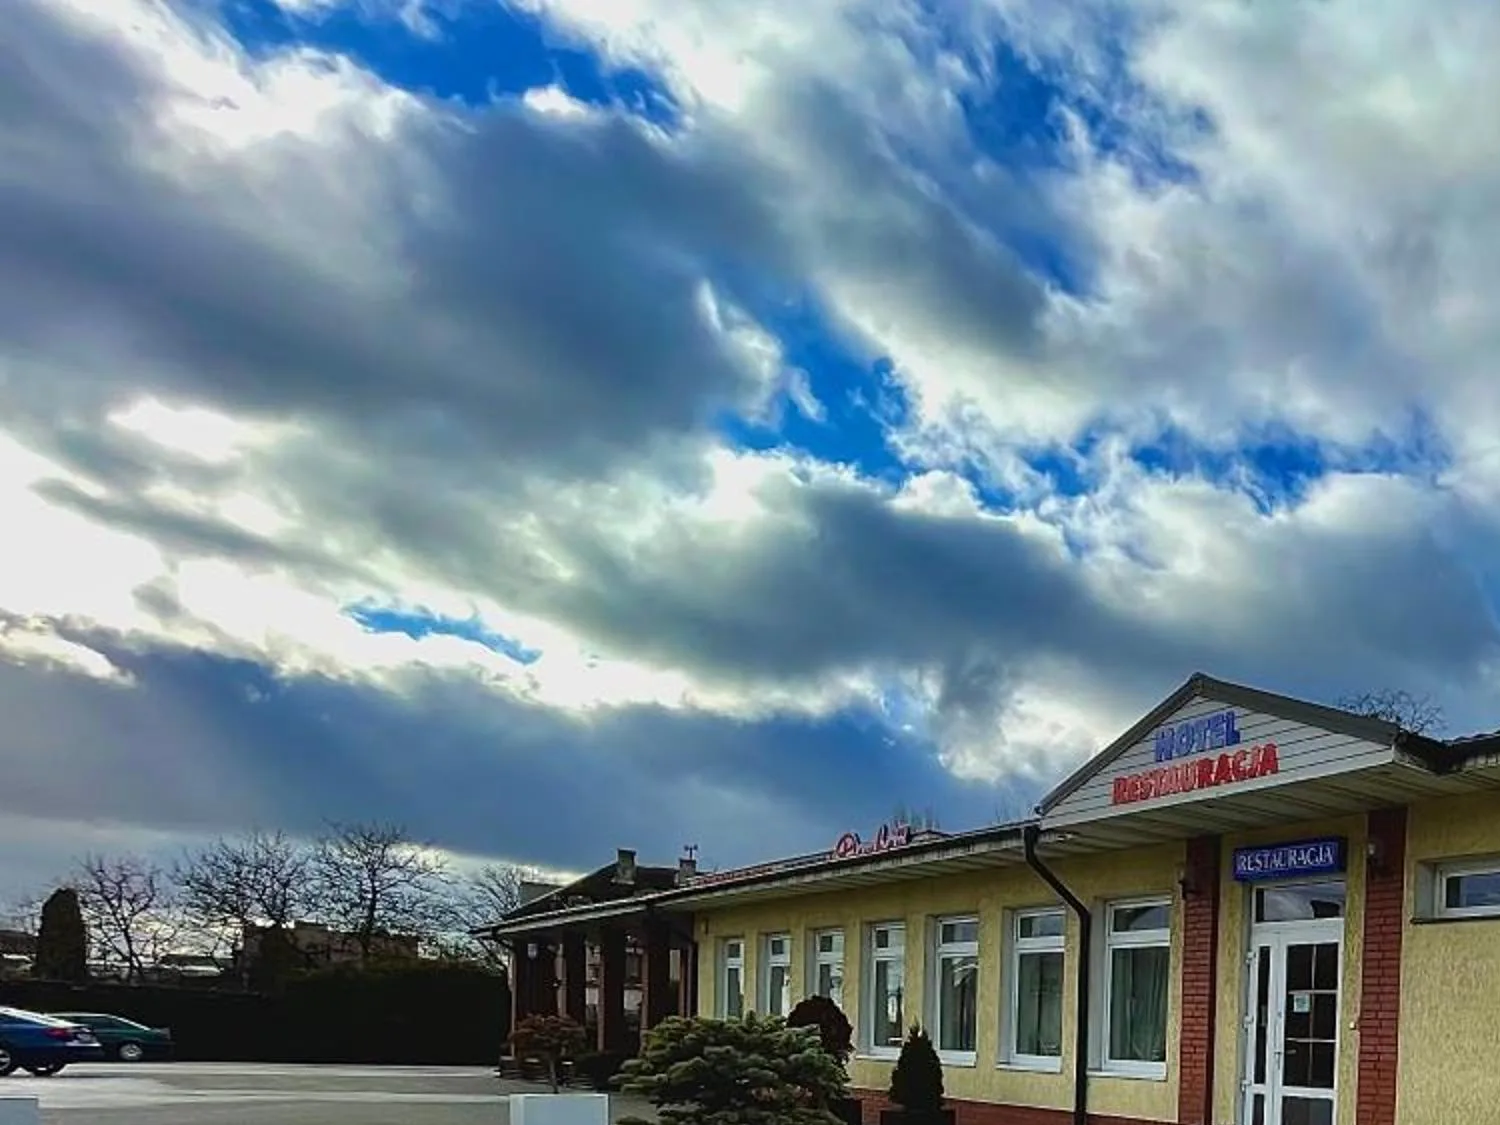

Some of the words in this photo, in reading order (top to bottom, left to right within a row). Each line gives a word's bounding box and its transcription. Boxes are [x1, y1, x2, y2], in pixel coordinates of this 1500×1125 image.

[1155, 711, 1240, 762] HOTEL
[1112, 742, 1279, 806] RESTAURACJA
[1238, 845, 1333, 872] RESTAURACJA
